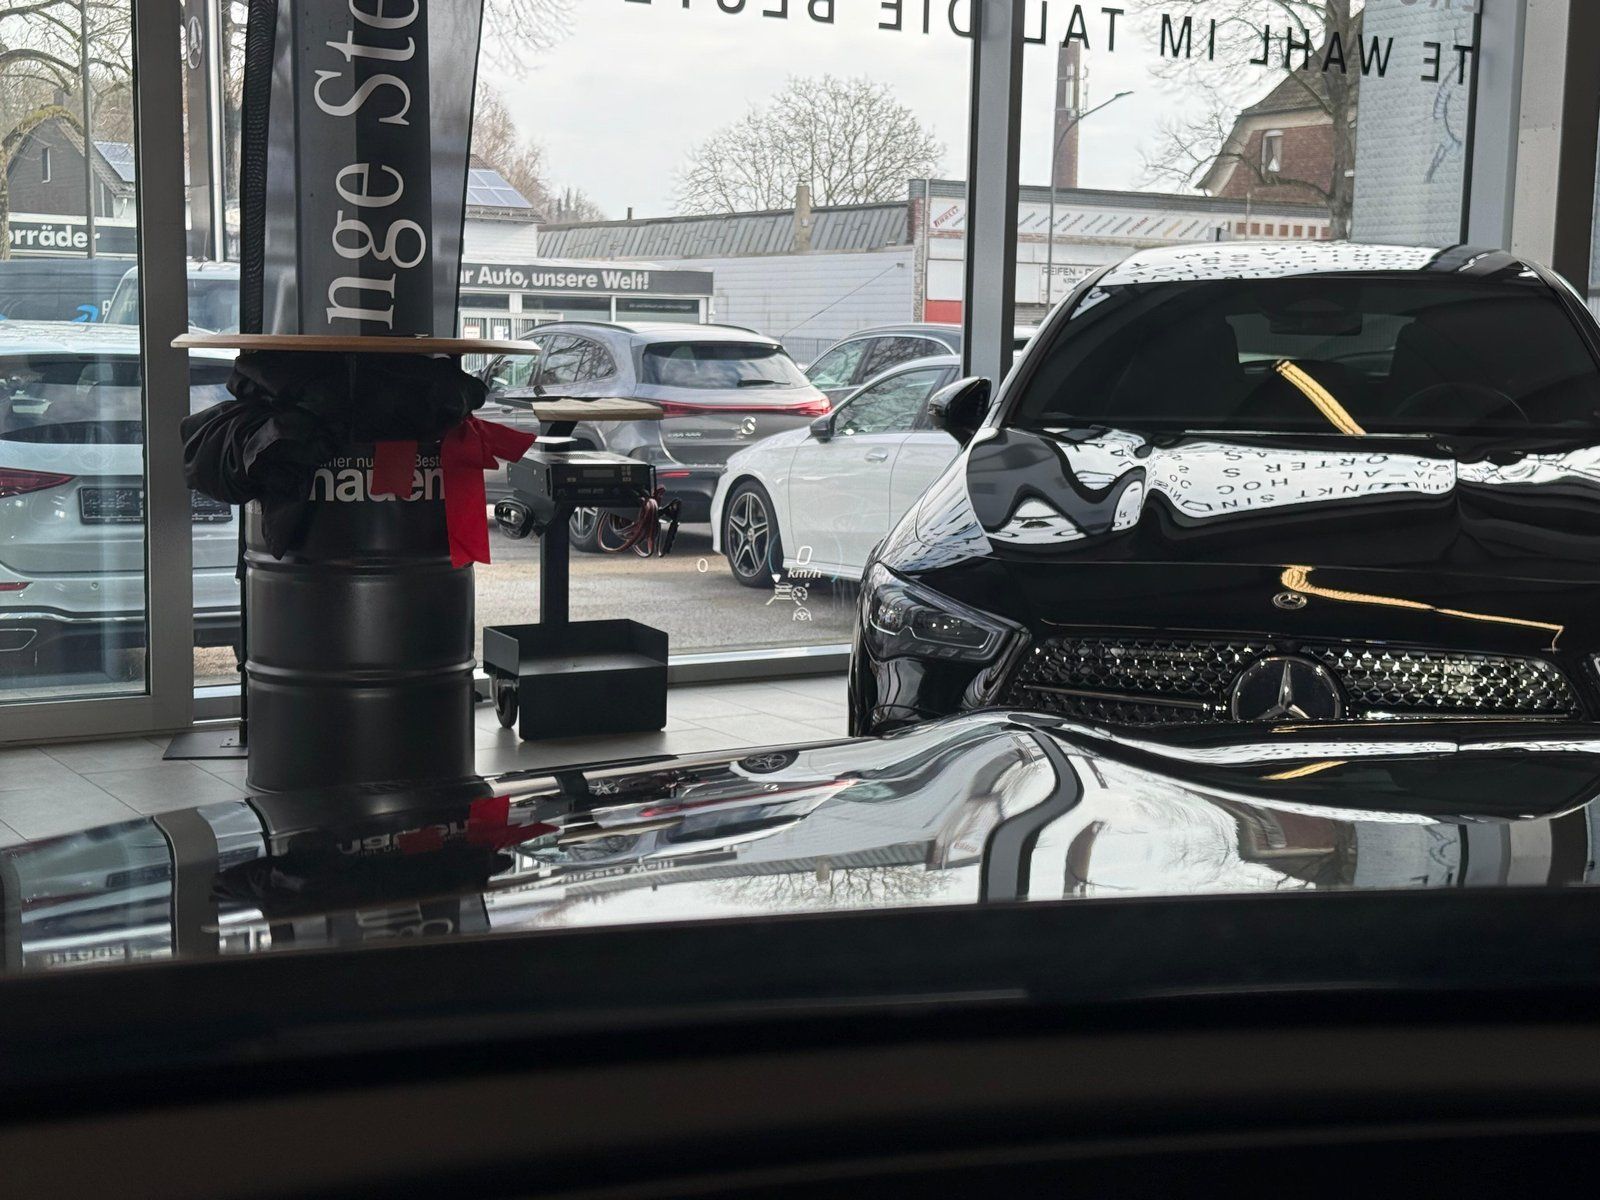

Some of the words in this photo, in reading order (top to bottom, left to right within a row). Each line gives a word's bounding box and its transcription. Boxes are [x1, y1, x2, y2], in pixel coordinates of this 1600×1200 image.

[8, 224, 101, 249] rräde
[478, 265, 530, 289] Auto,
[532, 272, 599, 289] unsere
[601, 270, 650, 290] Welt!
[787, 566, 823, 579] km/h
